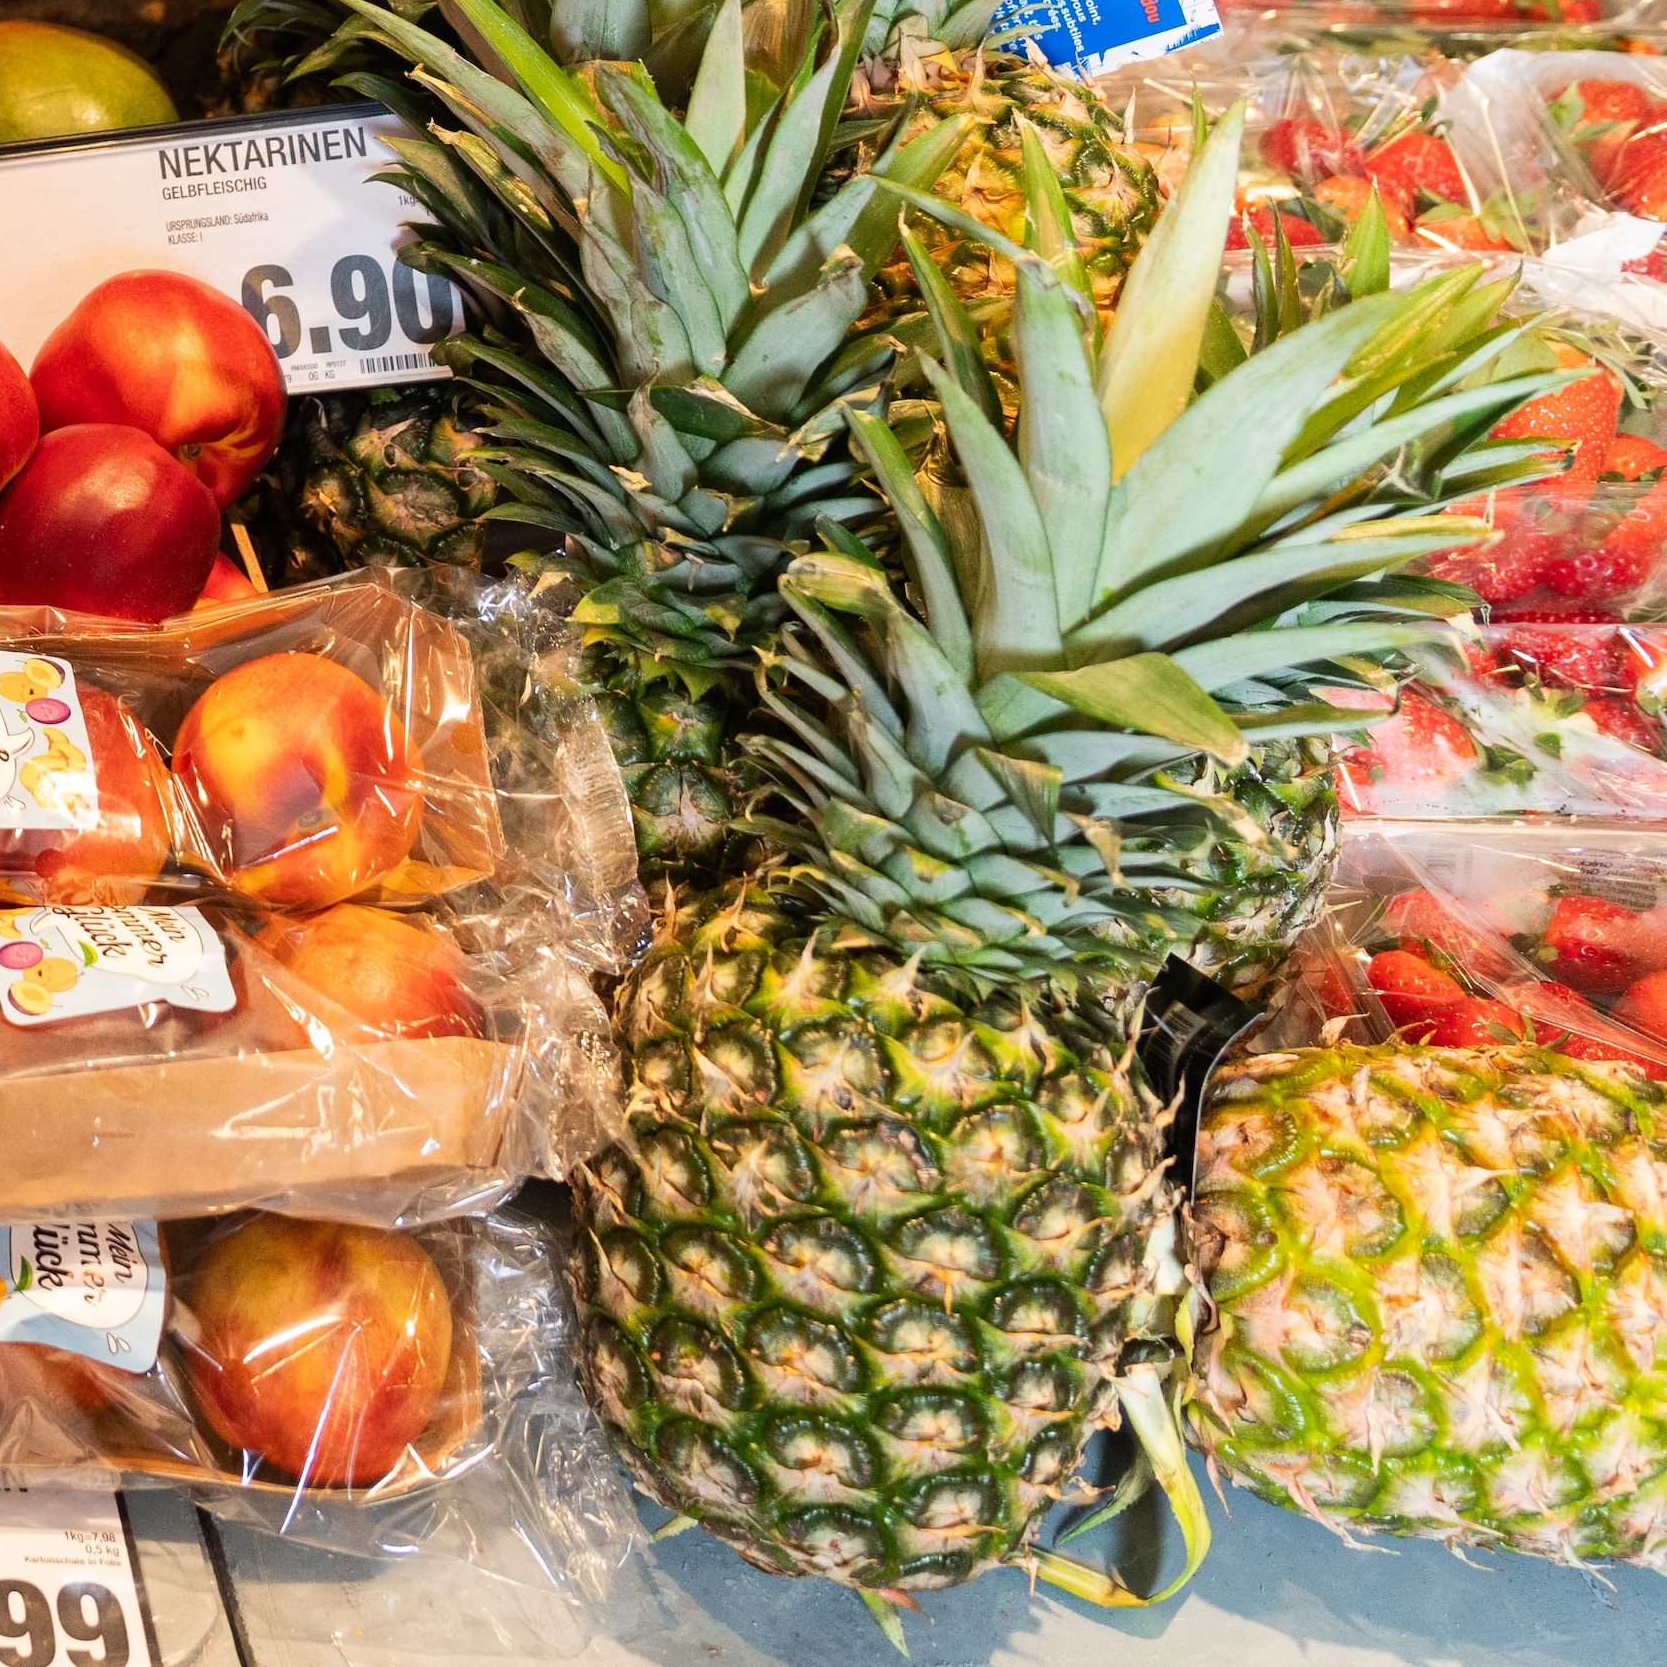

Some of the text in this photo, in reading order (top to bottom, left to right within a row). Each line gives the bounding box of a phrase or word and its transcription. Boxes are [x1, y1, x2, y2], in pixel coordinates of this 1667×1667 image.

[1060, 5, 1085, 53] subtiles
[158, 125, 367, 181] NEKTARINEN
[161, 176, 268, 200] GELBFLEISCHIG
[165, 209, 269, 233] URSPRUNGSLAND: Südafrika
[167, 231, 199, 245] KLASSE:
[241, 254, 454, 361] 6.90
[308, 369, 335, 381] OG KG
[64, 1530, 117, 1545] 1kg=7,98
[85, 1543, 120, 1557] 0,5 kg
[24, 1554, 122, 1567] Kartonschale in Folie
